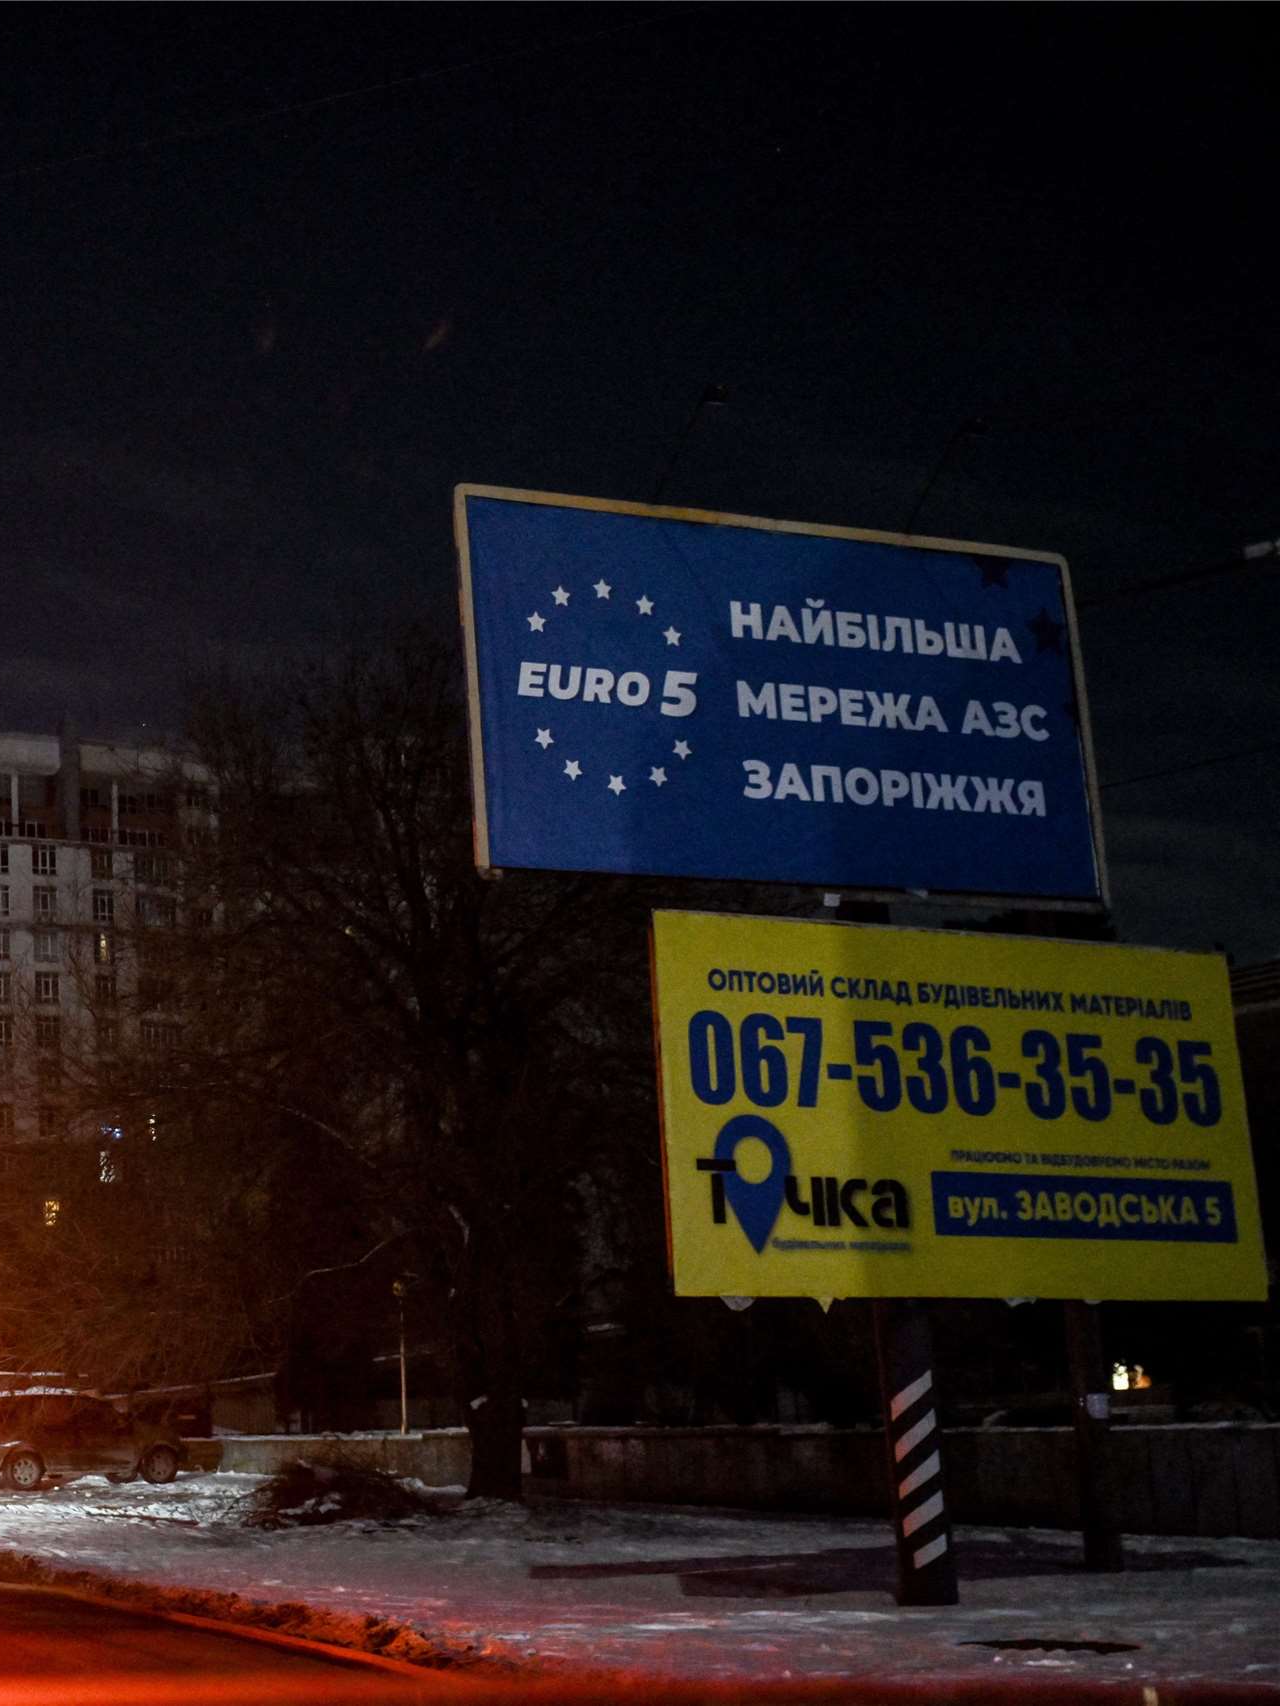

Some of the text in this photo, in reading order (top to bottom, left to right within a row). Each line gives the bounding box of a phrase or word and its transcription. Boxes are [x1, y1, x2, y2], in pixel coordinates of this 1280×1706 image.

[730, 597, 1023, 664] НАЙБІЛЬША
[518, 662, 698, 717] EURO 5
[736, 681, 1049, 742] МЕРЕЖА АЗС
[743, 760, 1046, 816] ЗАПОРІЖЖЯ
[708, 969, 1192, 1021] ОПТОВИЙ СКЛАД БУДІВЕЛЬНИХ МАТЕРІАЛІВ
[688, 1010, 1223, 1127] 067-536-35-35
[947, 1190, 1222, 1227] вул. ЗАВОДСЬКА 5
